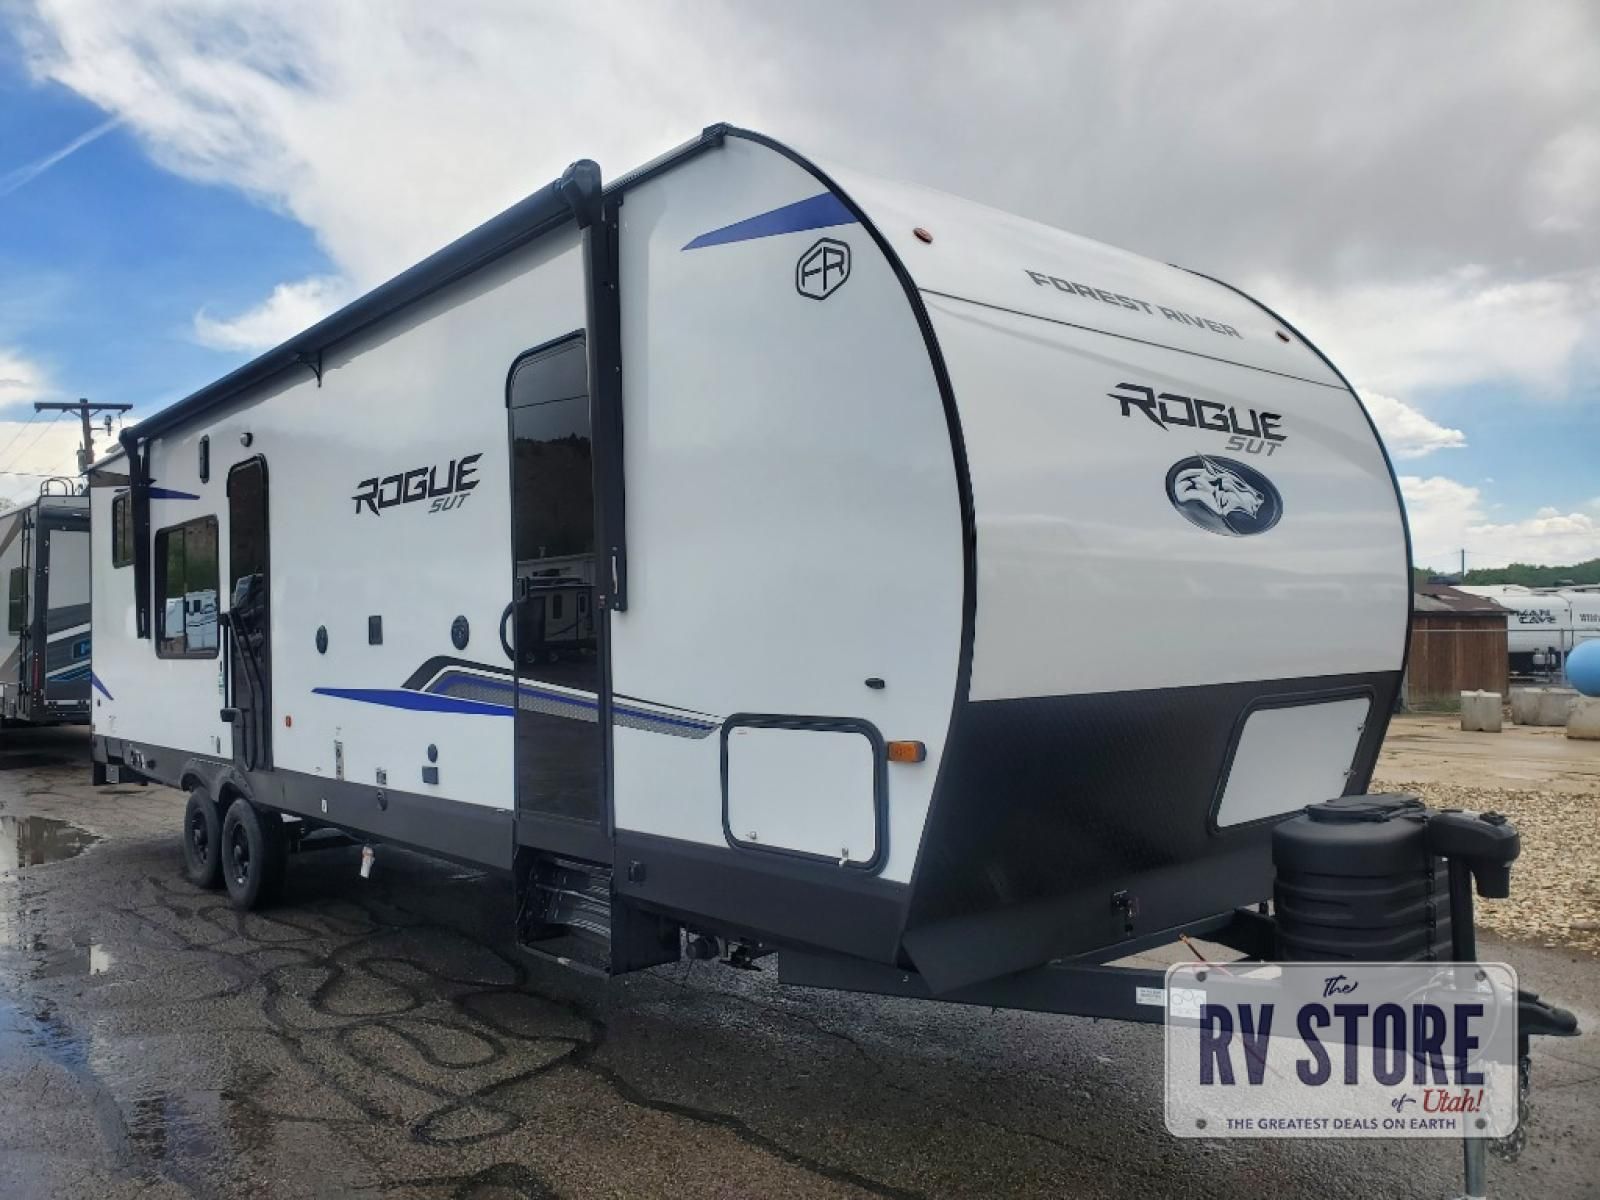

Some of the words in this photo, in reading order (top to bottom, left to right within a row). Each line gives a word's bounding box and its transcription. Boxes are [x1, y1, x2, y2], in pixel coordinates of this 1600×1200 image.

[1024, 269, 1153, 315] FOREST
[1157, 304, 1244, 340] RIVER
[1106, 382, 1288, 442] ROGUE
[1225, 435, 1282, 456] SUT
[351, 453, 484, 516] ROGUE
[428, 493, 471, 514] SUT
